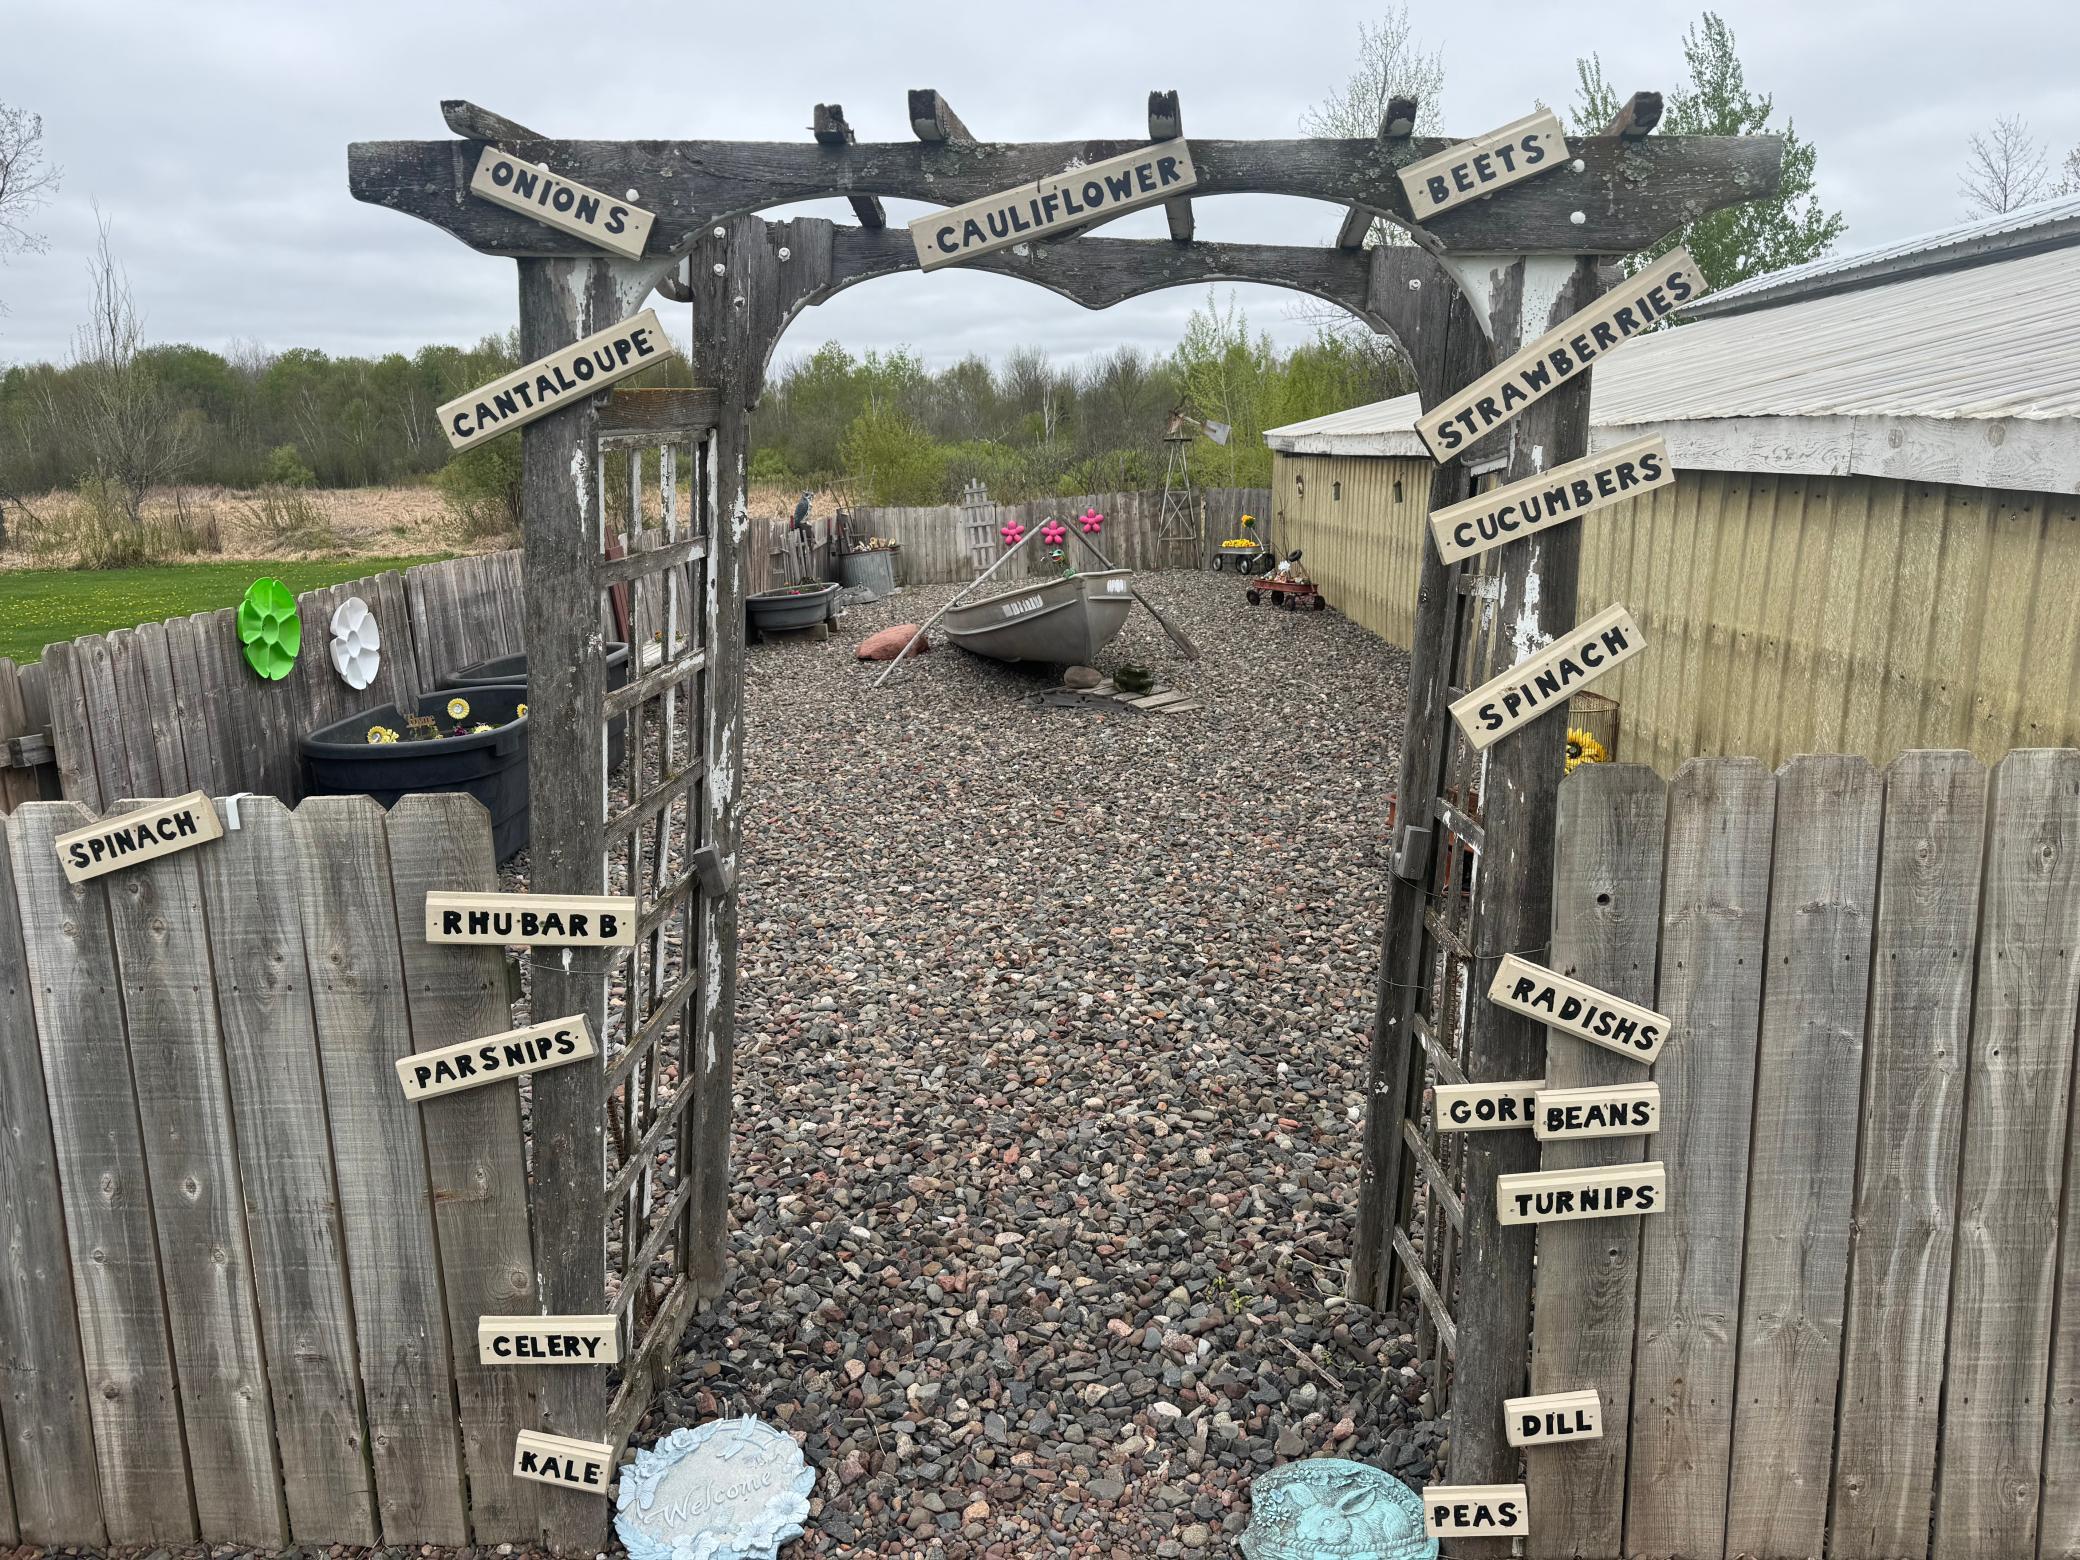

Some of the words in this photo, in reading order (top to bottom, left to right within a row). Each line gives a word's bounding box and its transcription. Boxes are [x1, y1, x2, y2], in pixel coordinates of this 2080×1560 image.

[491, 161, 629, 235] ONIONS
[1426, 134, 1545, 205] BEETS
[936, 156, 1182, 254] CAULIFLOWER
[453, 327, 655, 438] CANTALOUPE
[1437, 271, 1692, 449] STRAWBERRIES
[1453, 453, 1662, 548] CUCUMBERS
[1478, 625, 1629, 731] SPINACH
[69, 810, 198, 869] SPINACH
[442, 910, 618, 939] RHUBARB
[1511, 976, 1659, 1051] RADISHS
[414, 1030, 576, 1089] PARSNIPS
[1546, 1101, 1650, 1132] BEANS
[1514, 1185, 1655, 1217] TURNIPS
[492, 1334, 602, 1359] CELERY
[1521, 1409, 1593, 1437] DILL
[520, 1450, 601, 1485] KALE
[637, 1471, 772, 1528] Welcome
[1433, 1502, 1518, 1528] PEAS
